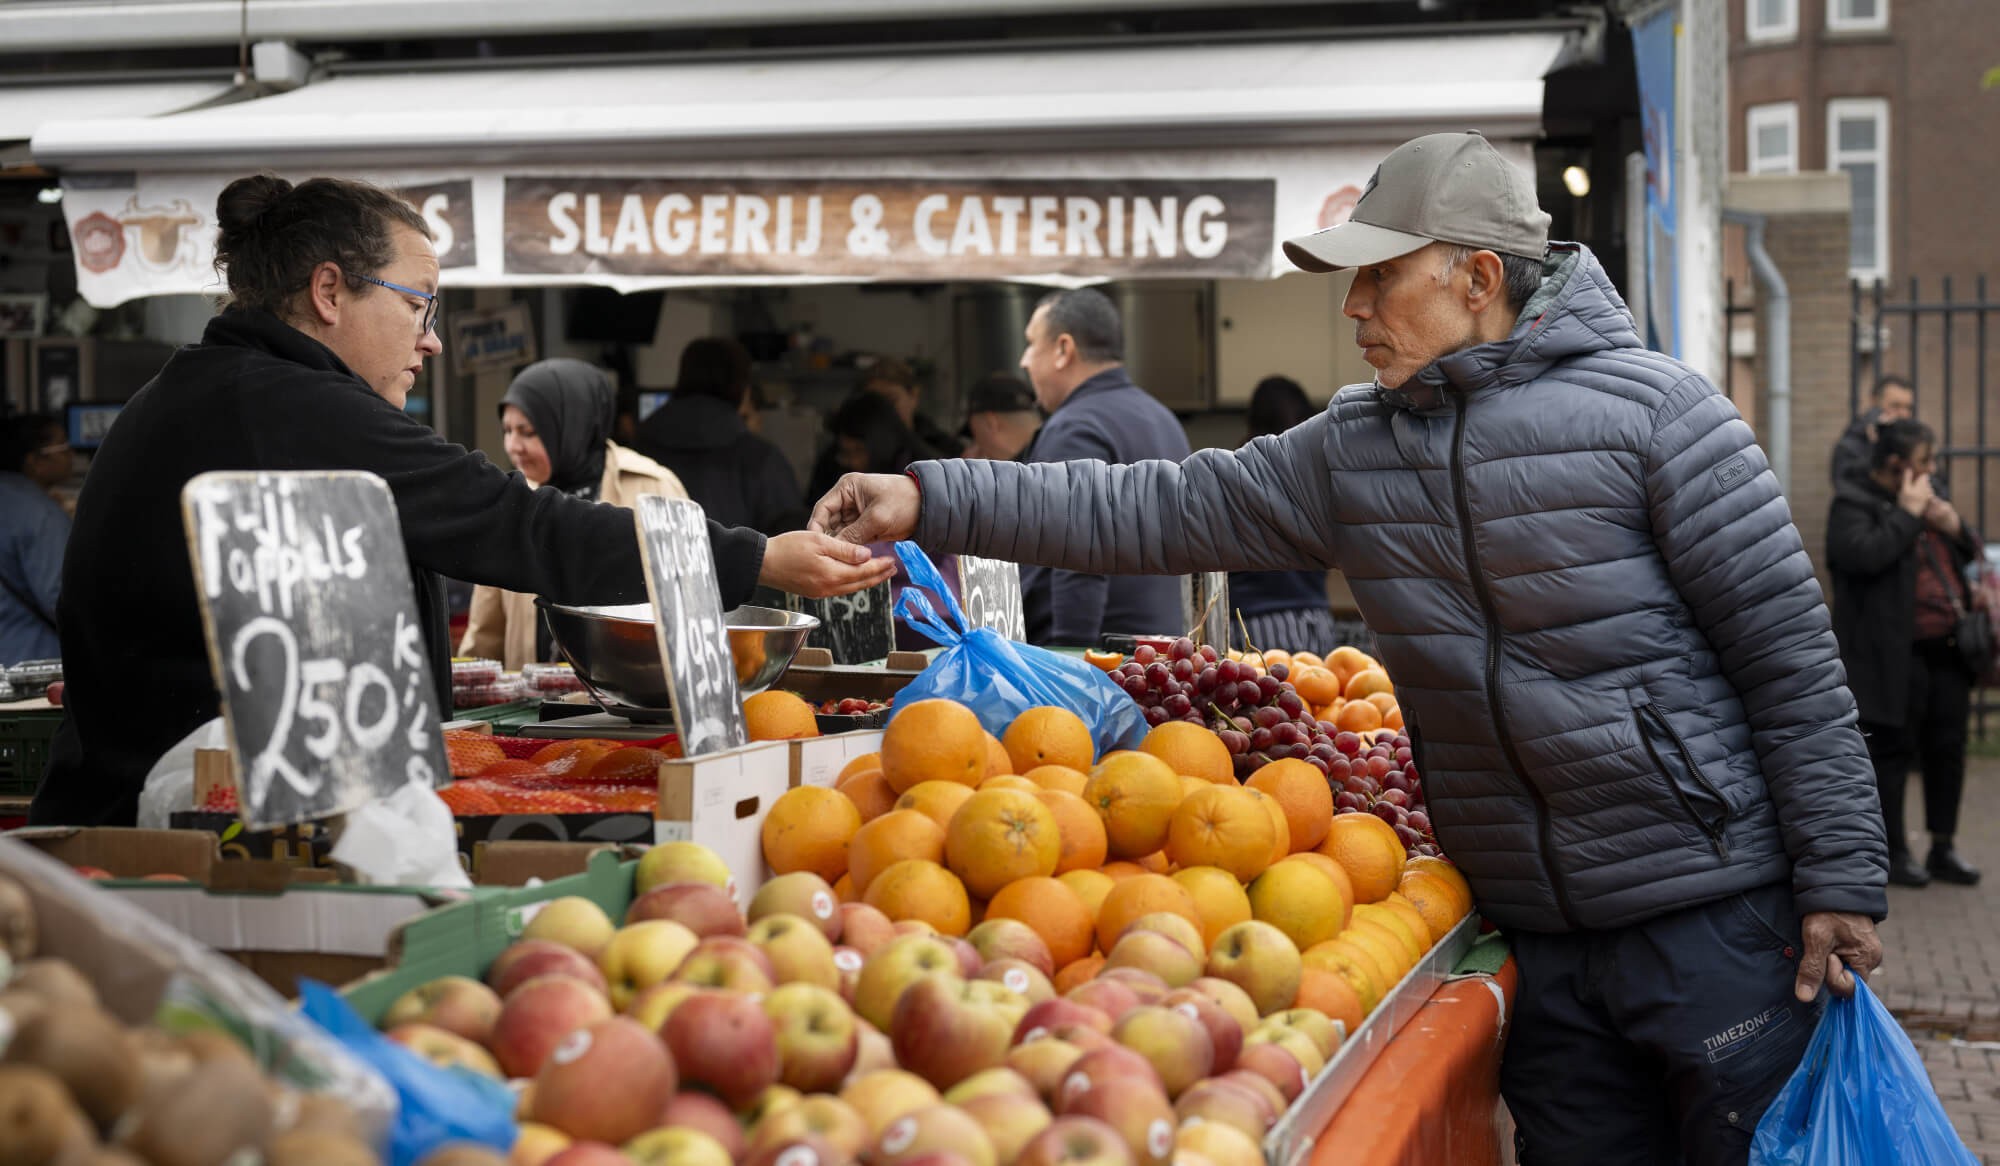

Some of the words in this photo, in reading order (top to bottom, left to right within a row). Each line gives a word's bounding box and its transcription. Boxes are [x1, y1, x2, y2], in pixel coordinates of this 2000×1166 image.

[547, 192, 823, 256] SLAGERIJ
[845, 194, 890, 257] &
[913, 194, 1229, 259] CATERING
[1703, 1009, 1771, 1050] TIMEZONE
